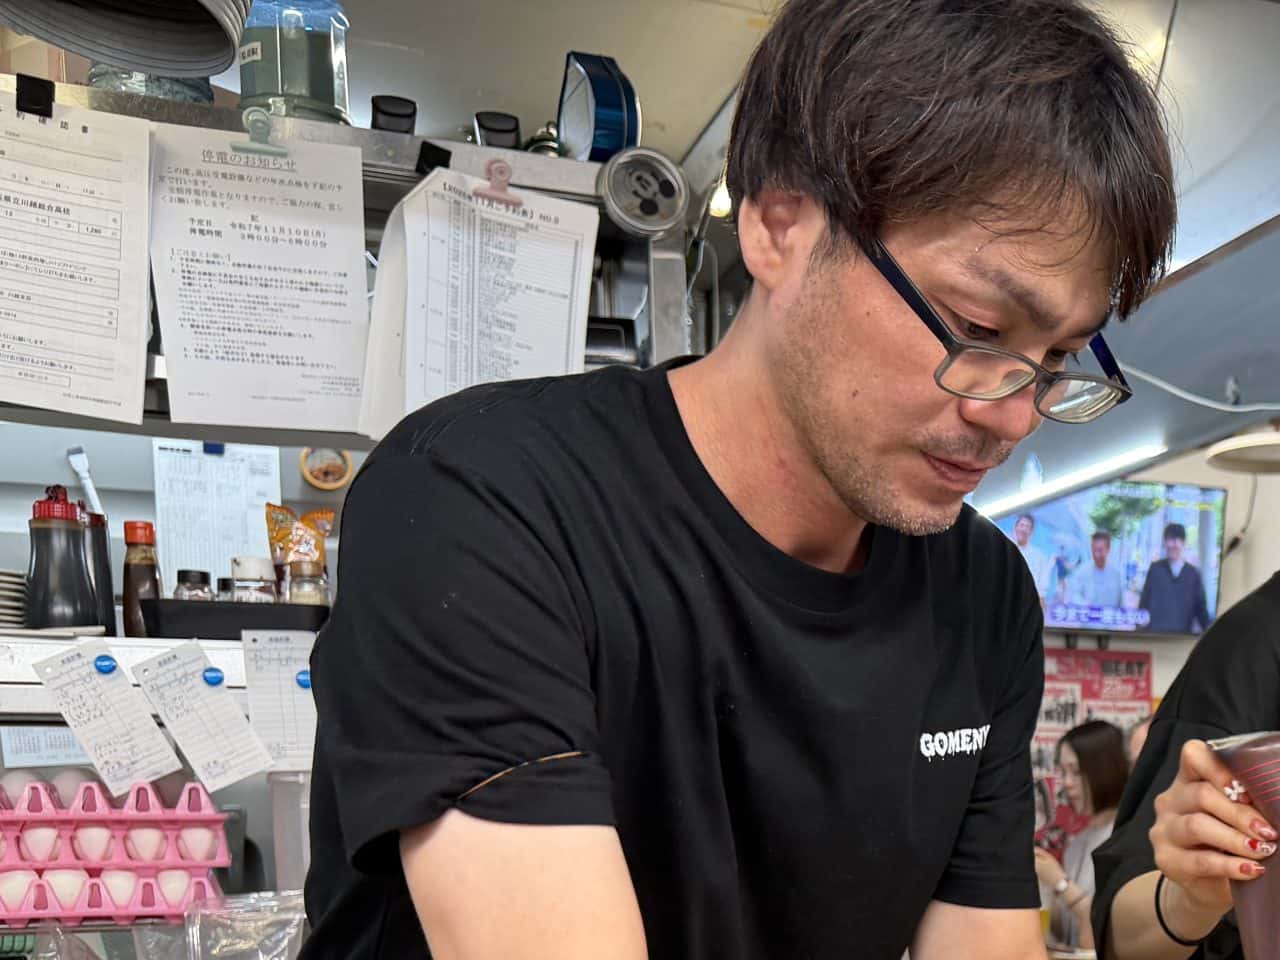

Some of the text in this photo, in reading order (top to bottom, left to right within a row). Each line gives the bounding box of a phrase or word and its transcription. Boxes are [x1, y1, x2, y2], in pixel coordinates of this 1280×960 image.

[201, 148, 297, 171] 停電のお知らせ
